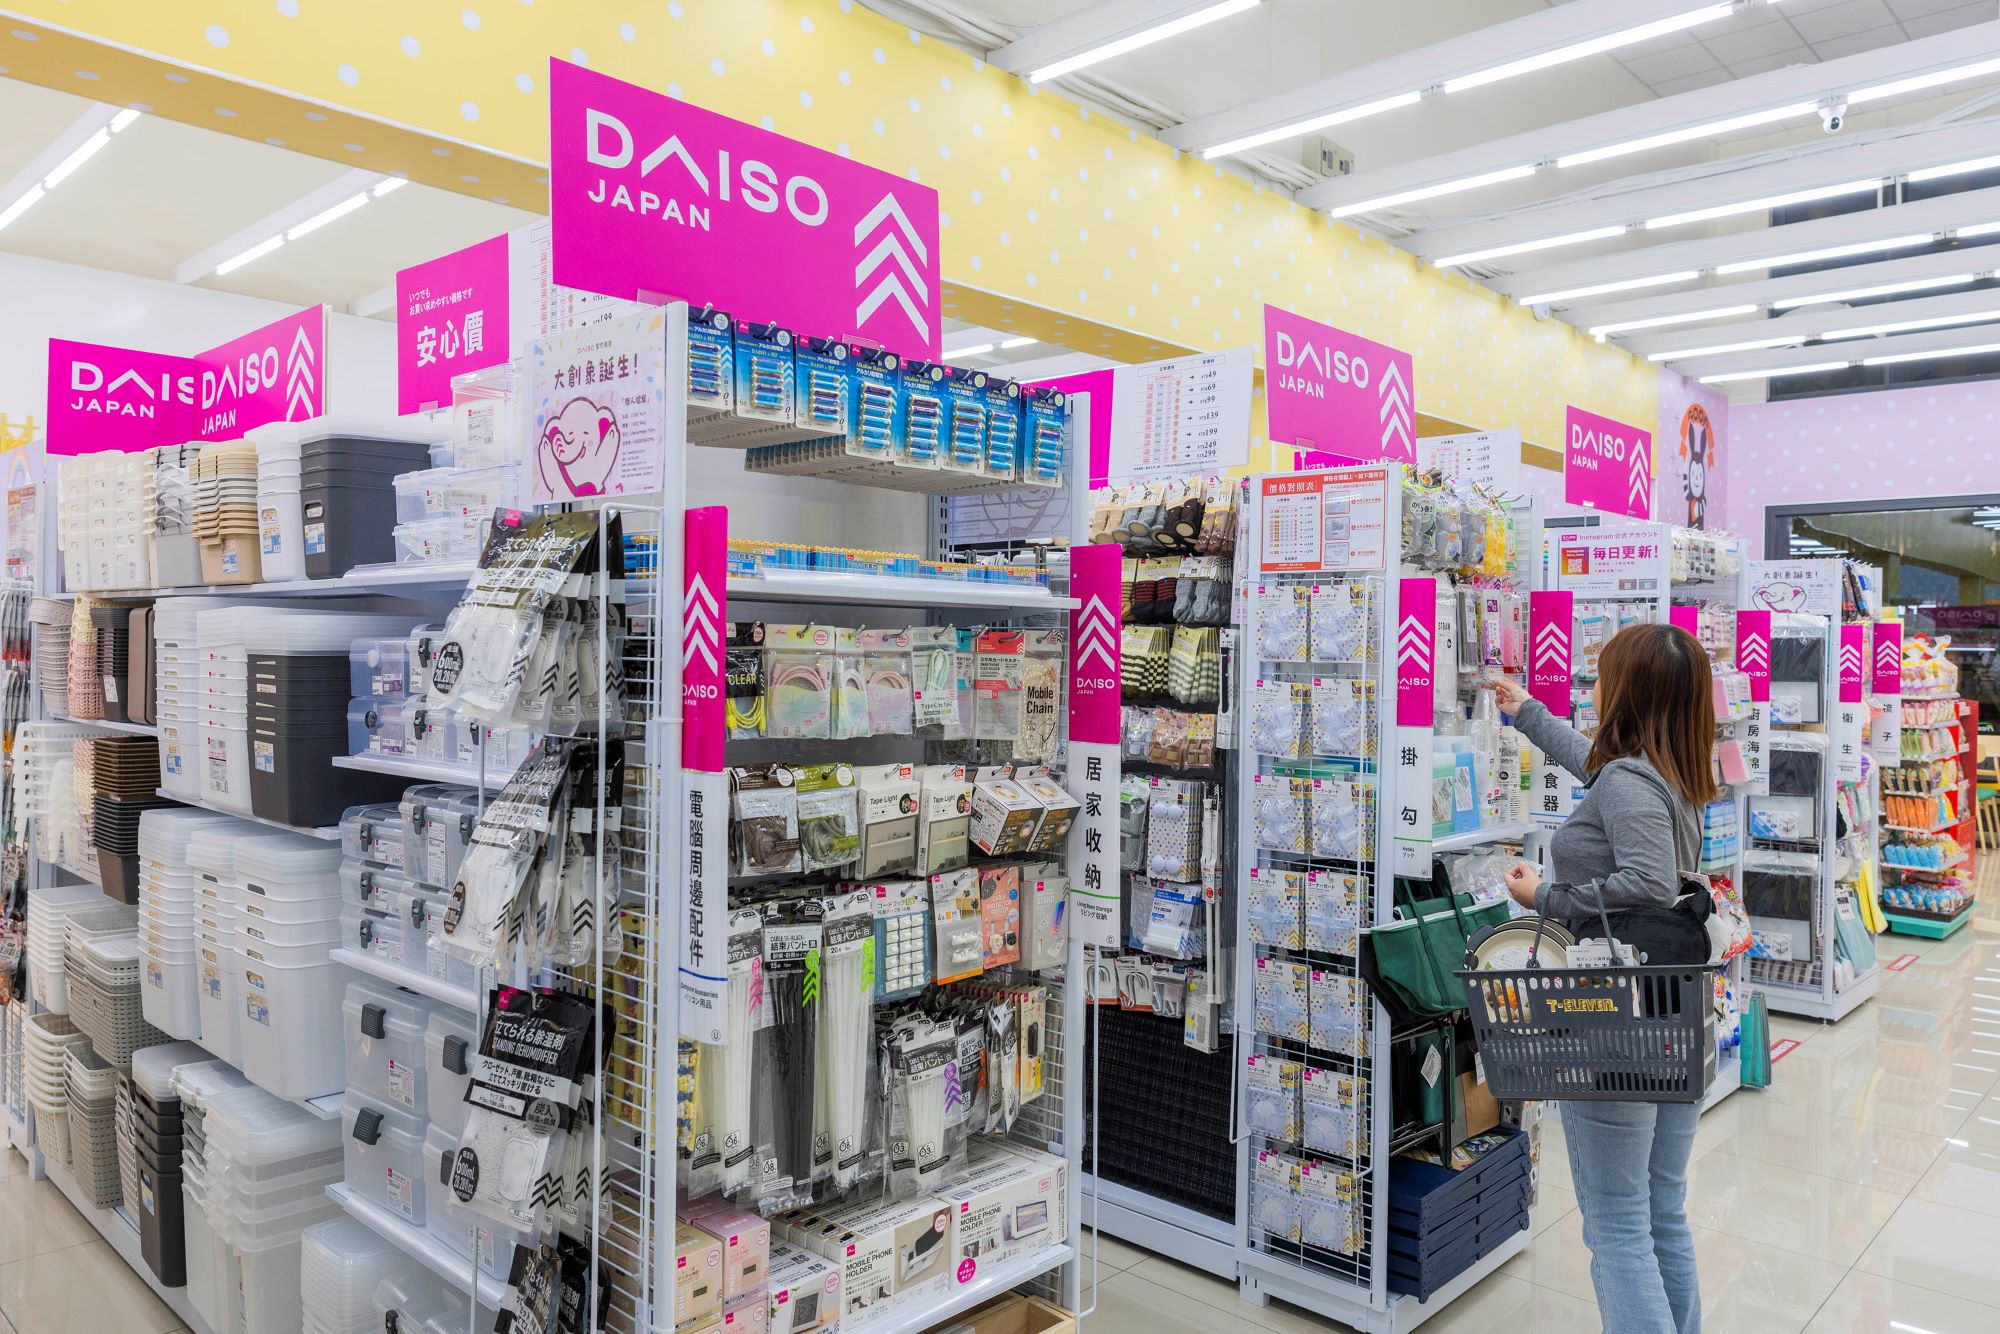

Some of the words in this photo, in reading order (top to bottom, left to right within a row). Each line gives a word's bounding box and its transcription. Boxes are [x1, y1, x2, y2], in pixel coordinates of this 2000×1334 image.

[586, 107, 829, 227] DAISO
[587, 179, 710, 232] JAPAN
[409, 287, 431, 303] いつでも
[416, 309, 484, 368] 安心價
[1276, 331, 1369, 389] DAISO
[71, 360, 194, 405] DAIS
[201, 346, 279, 410] DAISO
[1278, 373, 1324, 400] JAPAN
[71, 396, 154, 419] JAPAN
[201, 408, 236, 436] JAPAN
[1571, 423, 1625, 462] DAISO
[1571, 453, 1598, 471] JAPAN
[727, 673, 757, 686] CLEAR
[1076, 678, 1115, 689] DAISO
[1535, 674, 1568, 683] DAISO
[1027, 686, 1054, 700] Mobile
[1026, 700, 1054, 714] Chain
[1842, 712, 1854, 755] 衛生
[944, 794, 956, 802] Light
[1400, 746, 1419, 827] 掛勾
[869, 796, 884, 806] Tape
[884, 794, 898, 804] Light
[1085, 756, 1102, 890] 居家收納
[689, 789, 704, 968] 電腦周邊配件
[770, 941, 808, 951] 結束バンド
[495, 1020, 566, 1051] 立てられる除湿剤
[494, 1036, 516, 1054] TANDING
[515, 1042, 560, 1066] DEHUMIDIFIER
[910, 1057, 943, 1073] 結束バンド
[534, 1102, 554, 1118] 炭入
[960, 1213, 982, 1227] MOBILE
[982, 1205, 1002, 1218] PHONE
[960, 1219, 983, 1233] HOLDER
[845, 1256, 871, 1271] MOBILE
[871, 1247, 893, 1261] PHONE
[845, 1263, 873, 1279] HOLDER
